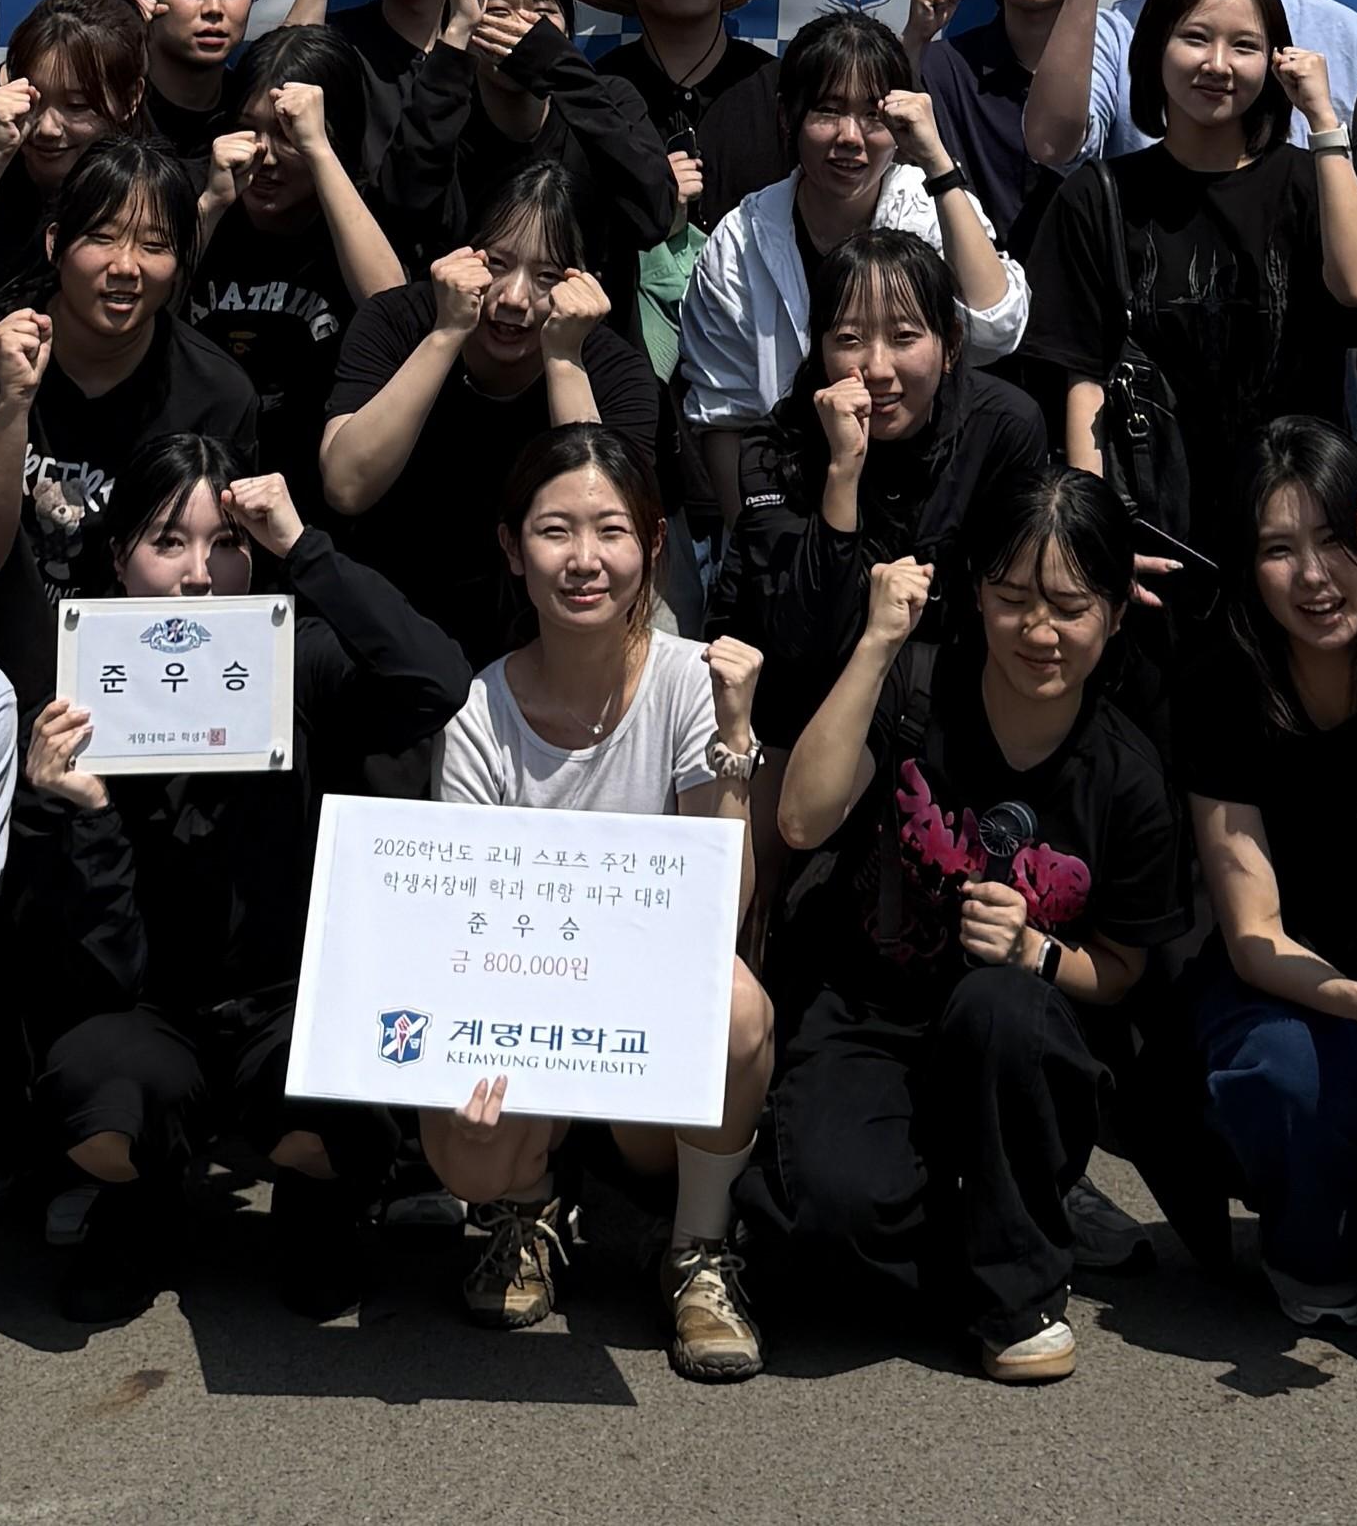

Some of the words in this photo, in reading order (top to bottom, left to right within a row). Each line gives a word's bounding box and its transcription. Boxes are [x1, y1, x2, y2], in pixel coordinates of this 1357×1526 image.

[99, 664, 129, 694] 준
[160, 661, 190, 693] 우
[221, 660, 251, 692] 승
[373, 837, 474, 863] 2026학년도
[485, 846, 522, 867] 교내
[532, 849, 590, 868] 스포츠
[600, 852, 638, 874] 주간
[649, 854, 687, 876] 행사
[383, 871, 477, 898] 학생처장배
[489, 878, 525, 901] 학과
[537, 881, 574, 904] 대항
[586, 884, 624, 907] 피구
[634, 887, 671, 909] 대회
[467, 912, 489, 935] 준
[512, 914, 535, 938] 우
[558, 916, 581, 941] 승
[449, 949, 472, 974] 금
[483, 951, 589, 982] 800,000원
[448, 1019, 650, 1054] 계명대학교
[446, 1050, 539, 1069] KEIMYUNG
[544, 1057, 648, 1076] UNIVERSITY
